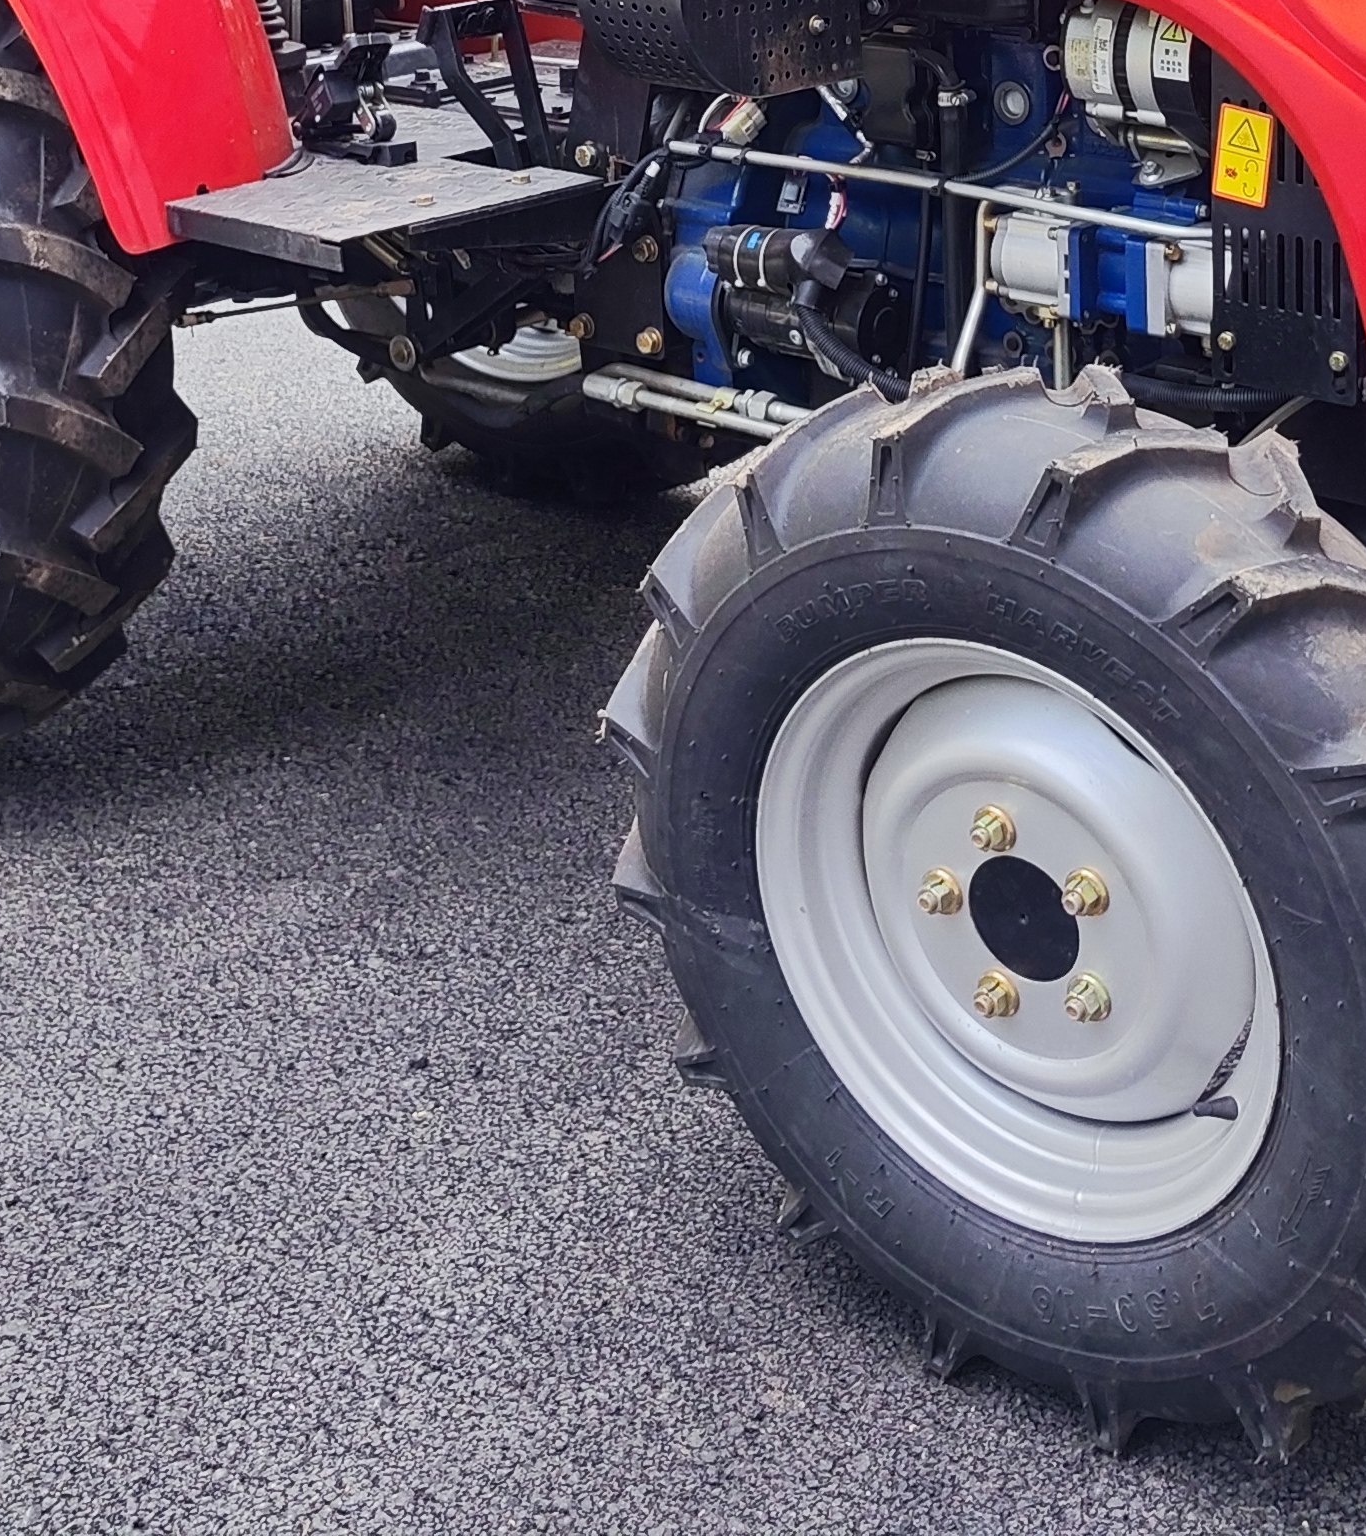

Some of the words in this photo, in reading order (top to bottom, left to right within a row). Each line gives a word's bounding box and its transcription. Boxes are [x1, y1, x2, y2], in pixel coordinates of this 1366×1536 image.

[772, 574, 932, 646] BUMPER
[984, 588, 1186, 727] HARVEST
[824, 1146, 897, 1220] R-1
[1030, 1272, 1220, 1337] 7.50-16
